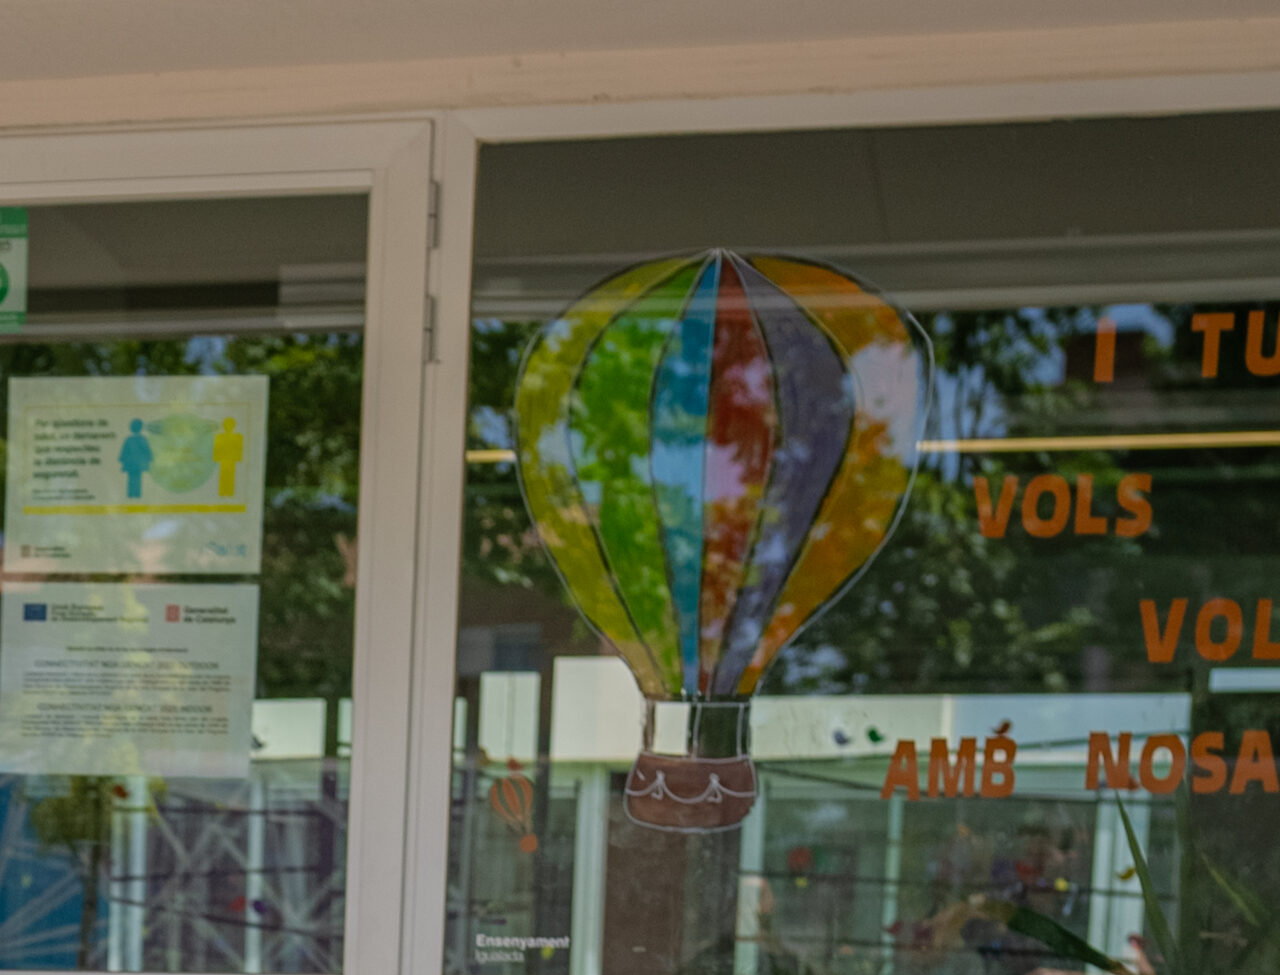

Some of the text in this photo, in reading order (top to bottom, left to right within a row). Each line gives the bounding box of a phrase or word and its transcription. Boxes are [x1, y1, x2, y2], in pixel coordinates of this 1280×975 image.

[1093, 309, 1280, 383] I TU
[973, 473, 1154, 539] VOLS
[1139, 598, 1280, 663] VOL
[880, 730, 1280, 801] AMB NOSA
[475, 933, 570, 951] Ensenyament
